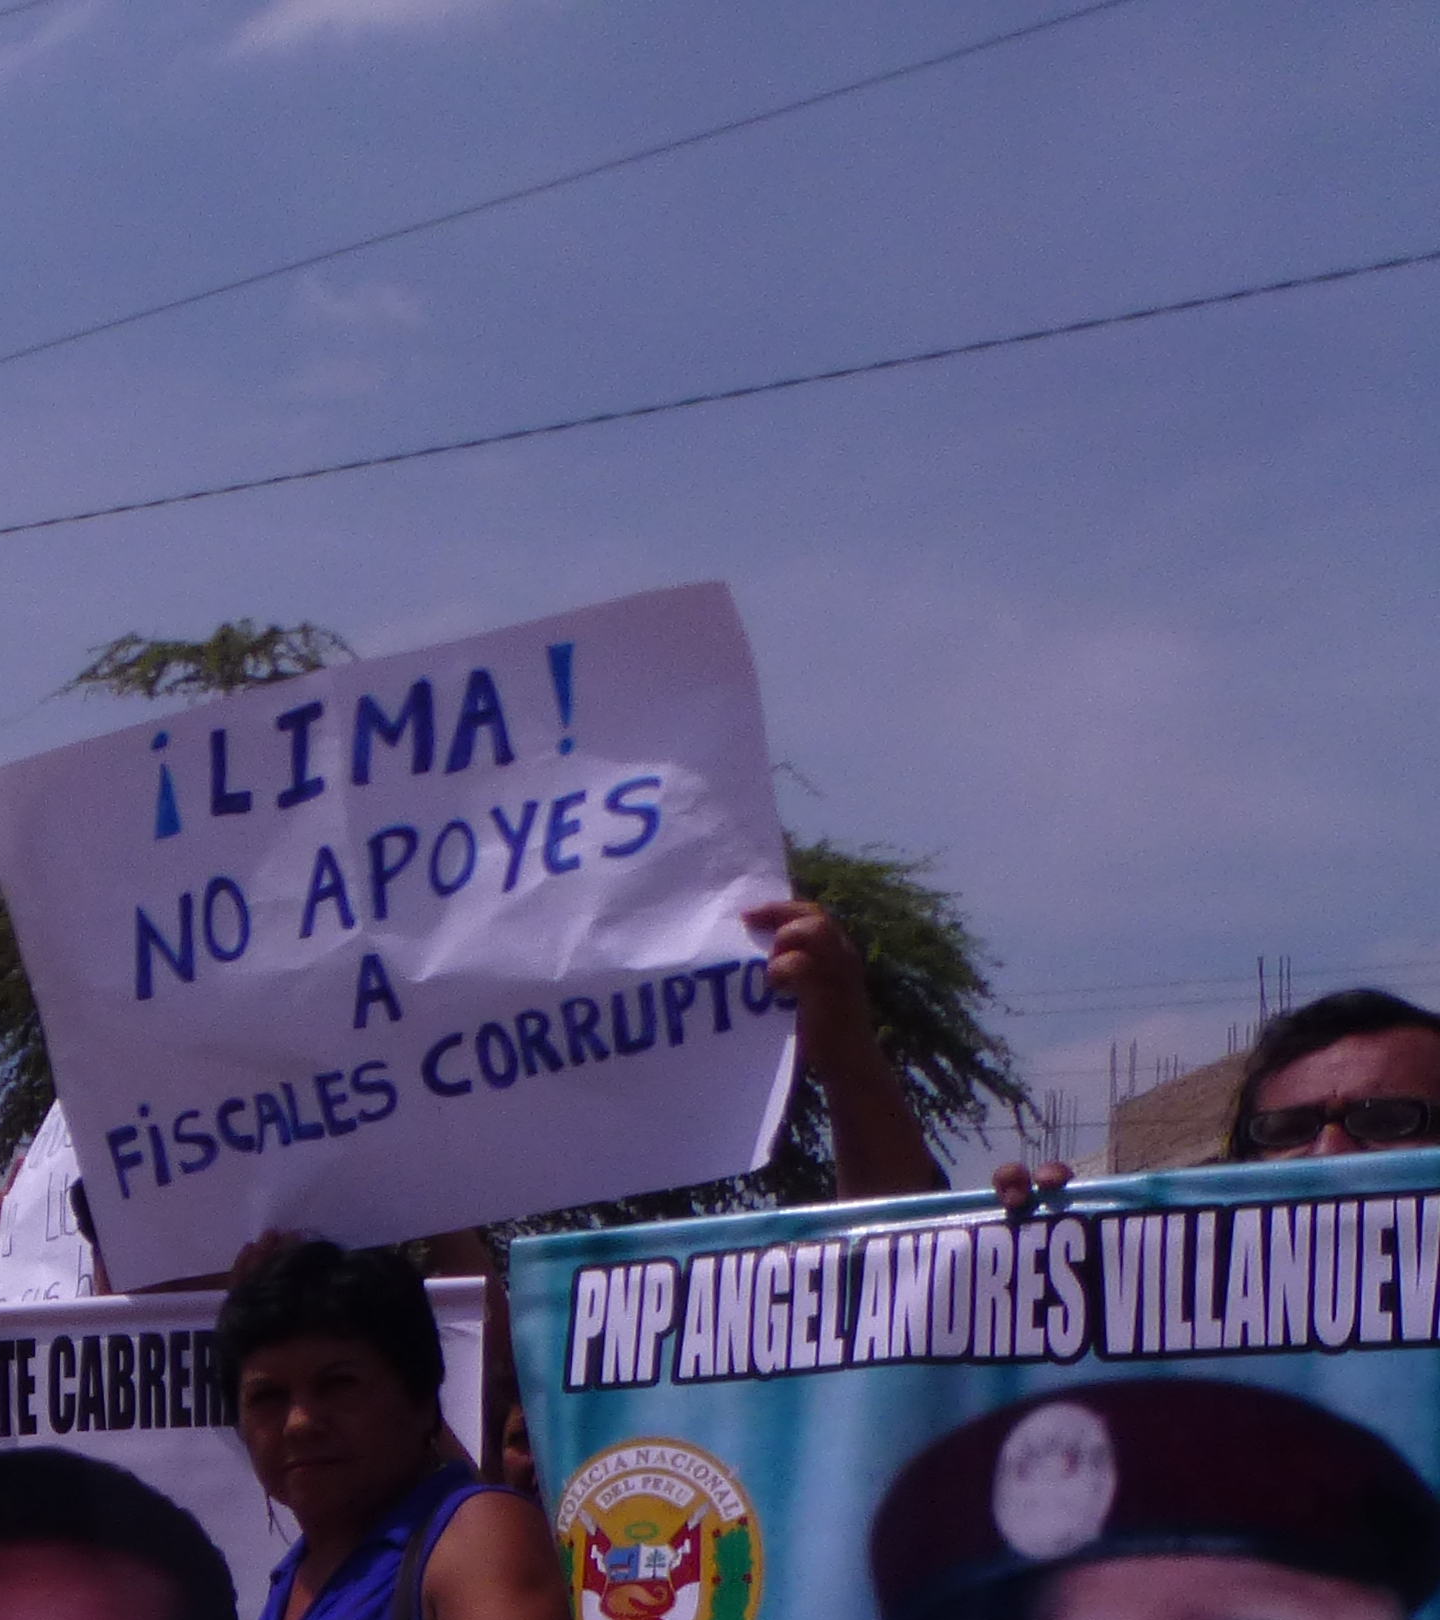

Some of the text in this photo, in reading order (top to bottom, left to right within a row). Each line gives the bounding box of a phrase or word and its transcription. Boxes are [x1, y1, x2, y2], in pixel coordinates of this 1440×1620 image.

[135, 777, 663, 1001] NO APOYES
[353, 954, 403, 1029] A
[422, 957, 801, 1098] CORRUPTO
[567, 1193, 1440, 1391] PNP ANGEL ANDRES VILLANUEV
[48, 1330, 239, 1434] CABRER
